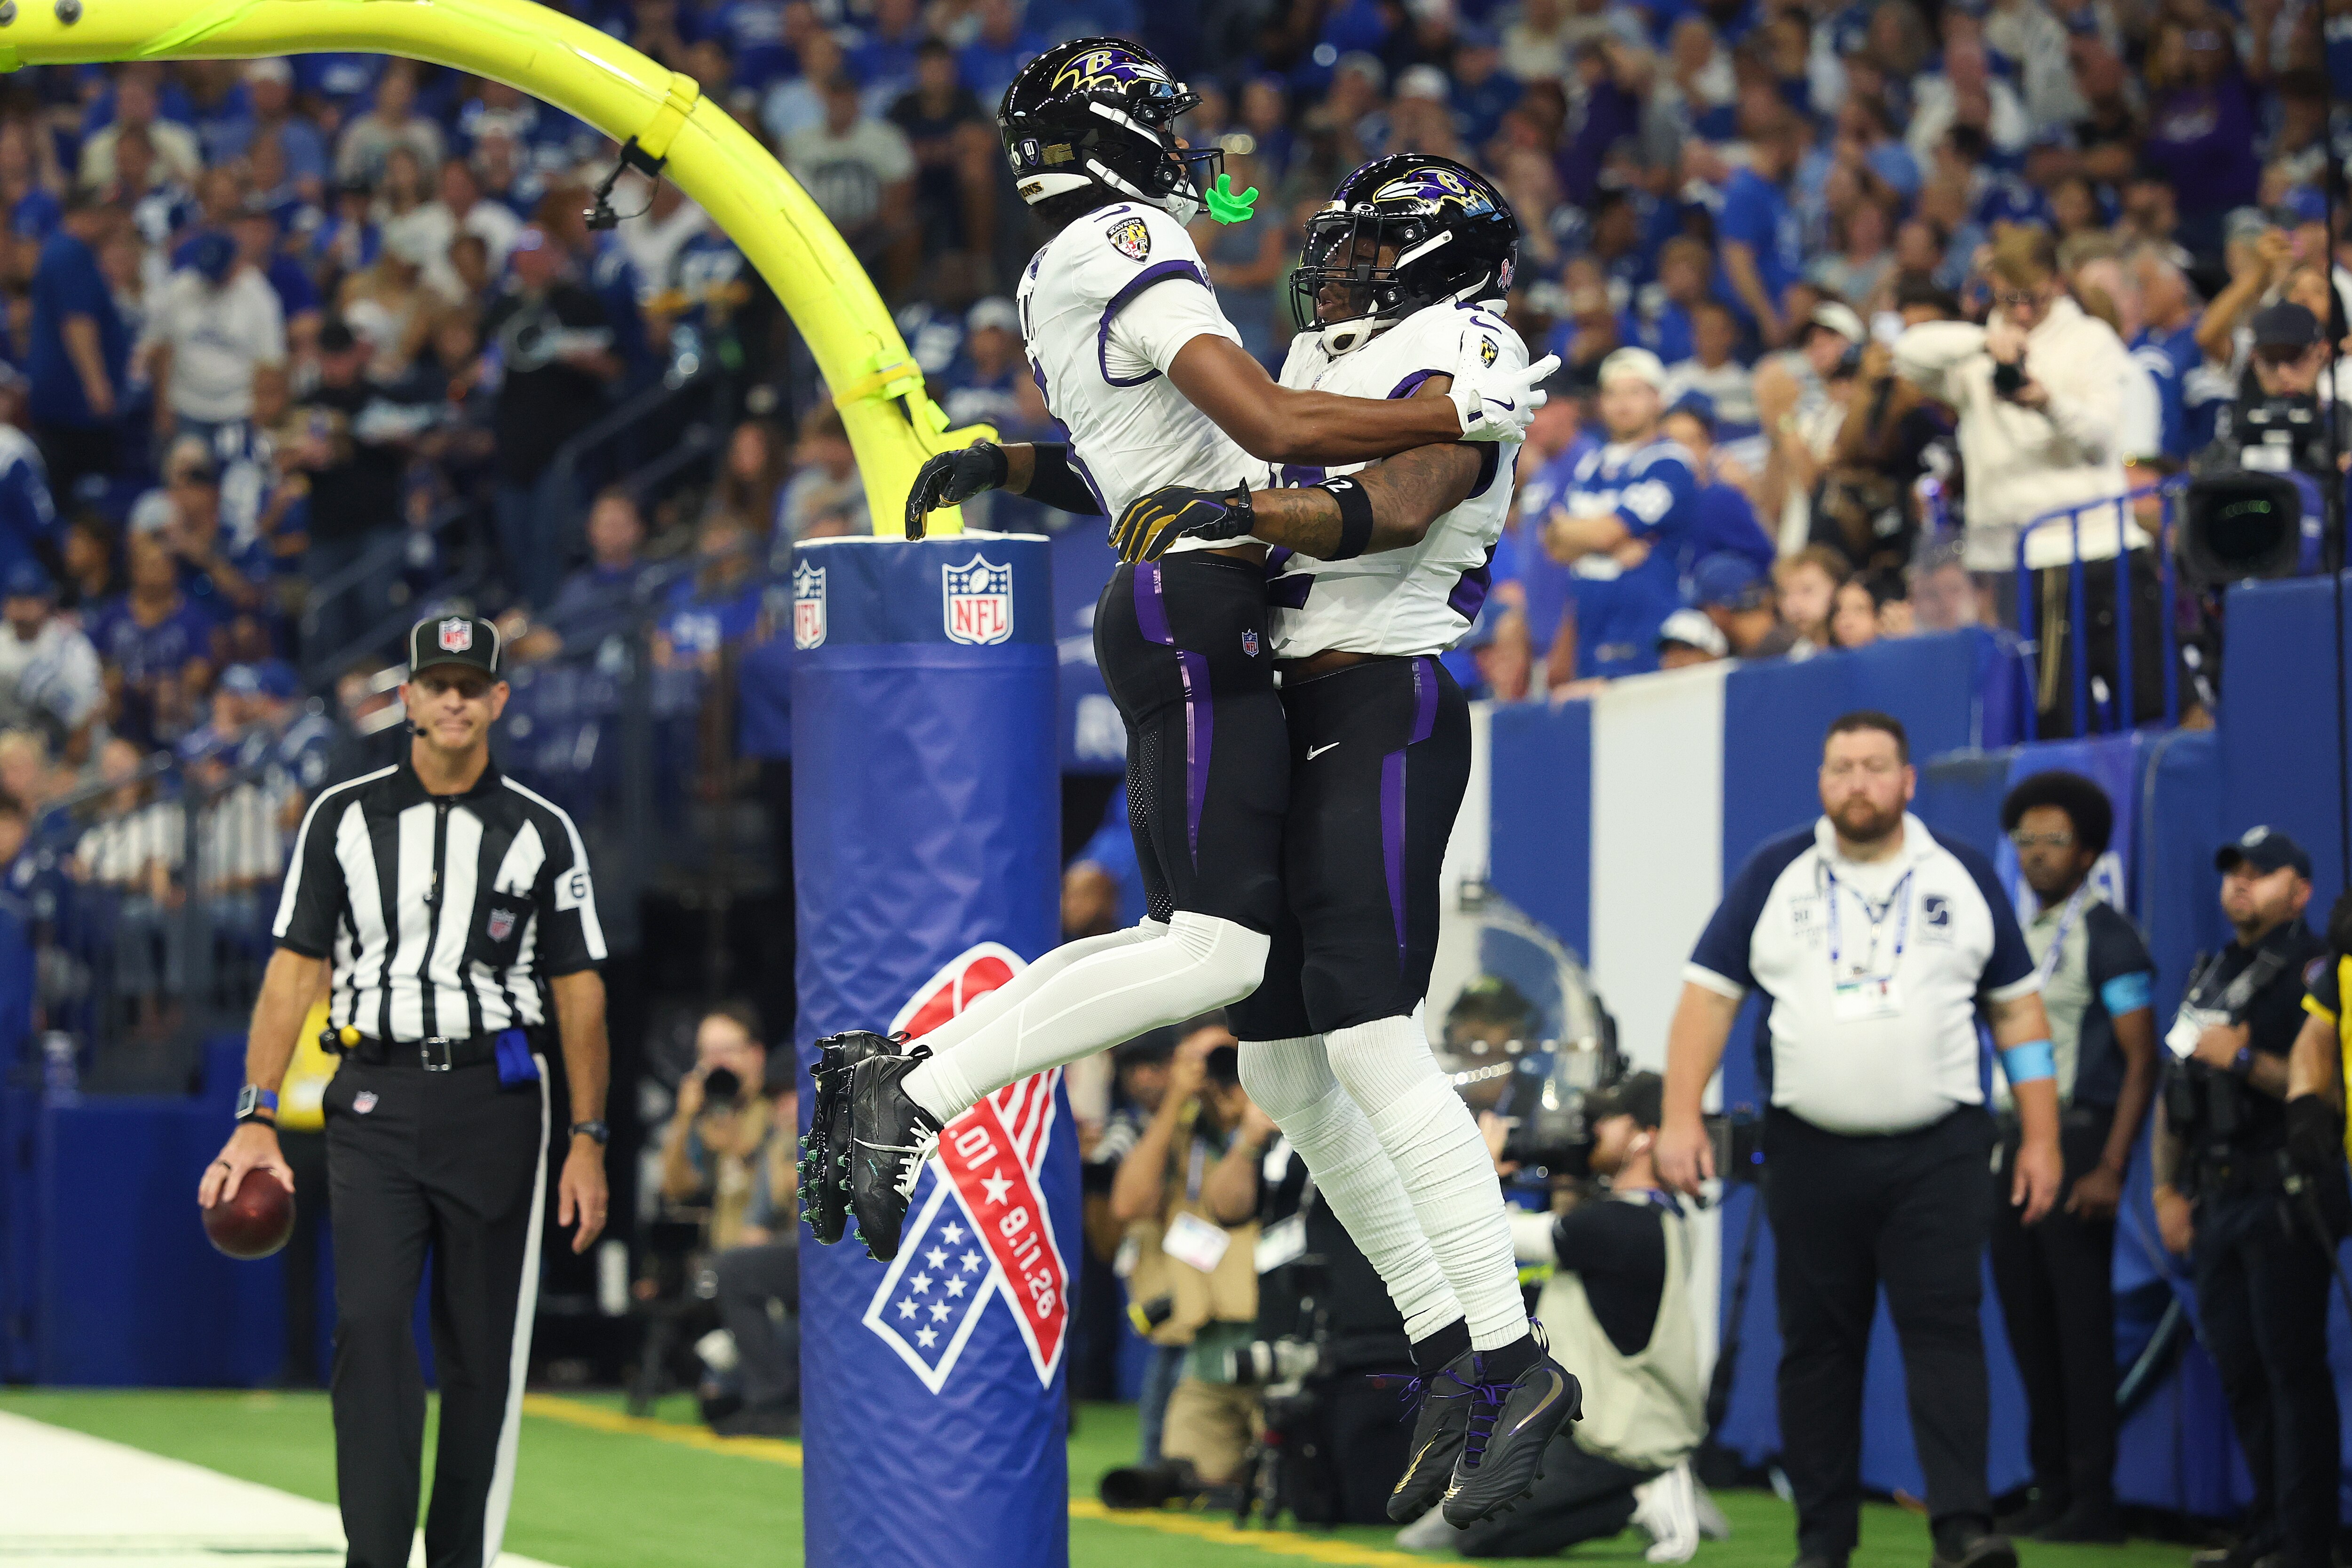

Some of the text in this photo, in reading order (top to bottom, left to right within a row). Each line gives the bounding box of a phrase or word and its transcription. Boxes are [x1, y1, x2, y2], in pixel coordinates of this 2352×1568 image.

[1079, 51, 1112, 76] B
[1108, 219, 1141, 235] RAVENS
[955, 600, 1004, 637] NFL
[1246, 642, 1257, 653] NFL
